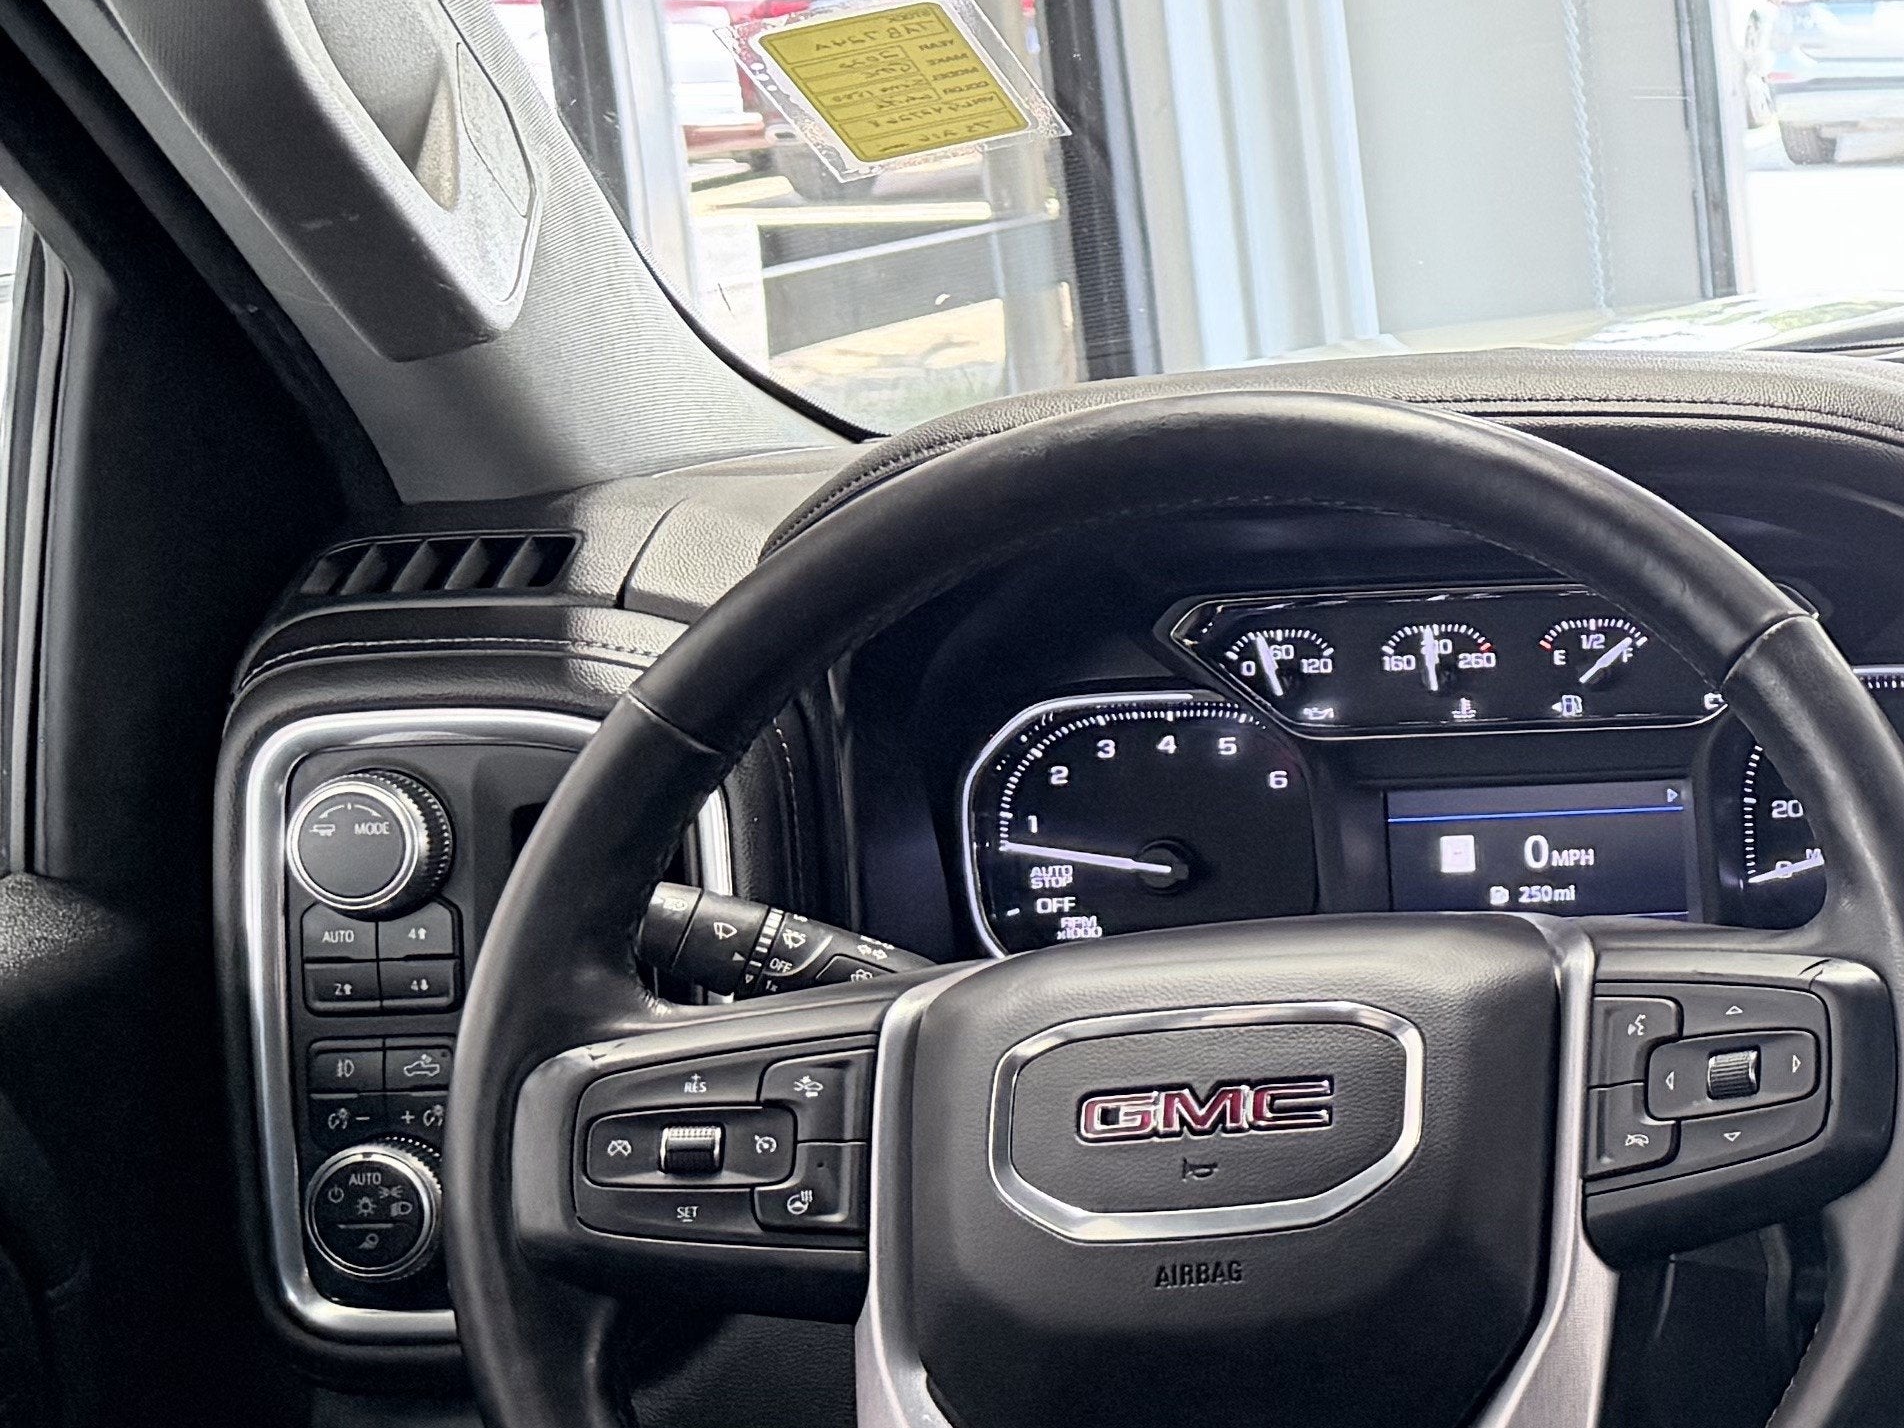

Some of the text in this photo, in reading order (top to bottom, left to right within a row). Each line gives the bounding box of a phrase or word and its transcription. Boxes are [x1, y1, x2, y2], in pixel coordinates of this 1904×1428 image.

[1382, 654, 1416, 671] 160
[1458, 652, 1497, 669] 260
[1553, 649, 1567, 666] E
[1622, 647, 1634, 663] F
[1241, 660, 1256, 676] 0
[1301, 658, 1333, 674] 120
[1097, 739, 1116, 758] 3
[1157, 735, 1177, 755] 4
[1217, 736, 1238, 756] 5
[1050, 765, 1070, 785] 2
[1269, 770, 1289, 789] 6
[1771, 799, 1804, 819] 20
[354, 820, 391, 837] MODE
[1027, 814, 1039, 834] 1
[1523, 834, 1596, 869] 0 MPH
[1030, 864, 1074, 878] AUTO
[1030, 876, 1074, 890] STOP
[1036, 897, 1076, 914] OFF
[321, 929, 355, 944] AUTO
[768, 958, 793, 974] OFF
[683, 1081, 708, 1093] RES
[1080, 1077, 1332, 1142] GMC
[348, 1173, 383, 1188] AUTO
[676, 1206, 700, 1219] SET
[1154, 1259, 1243, 1289] AIRBAG
